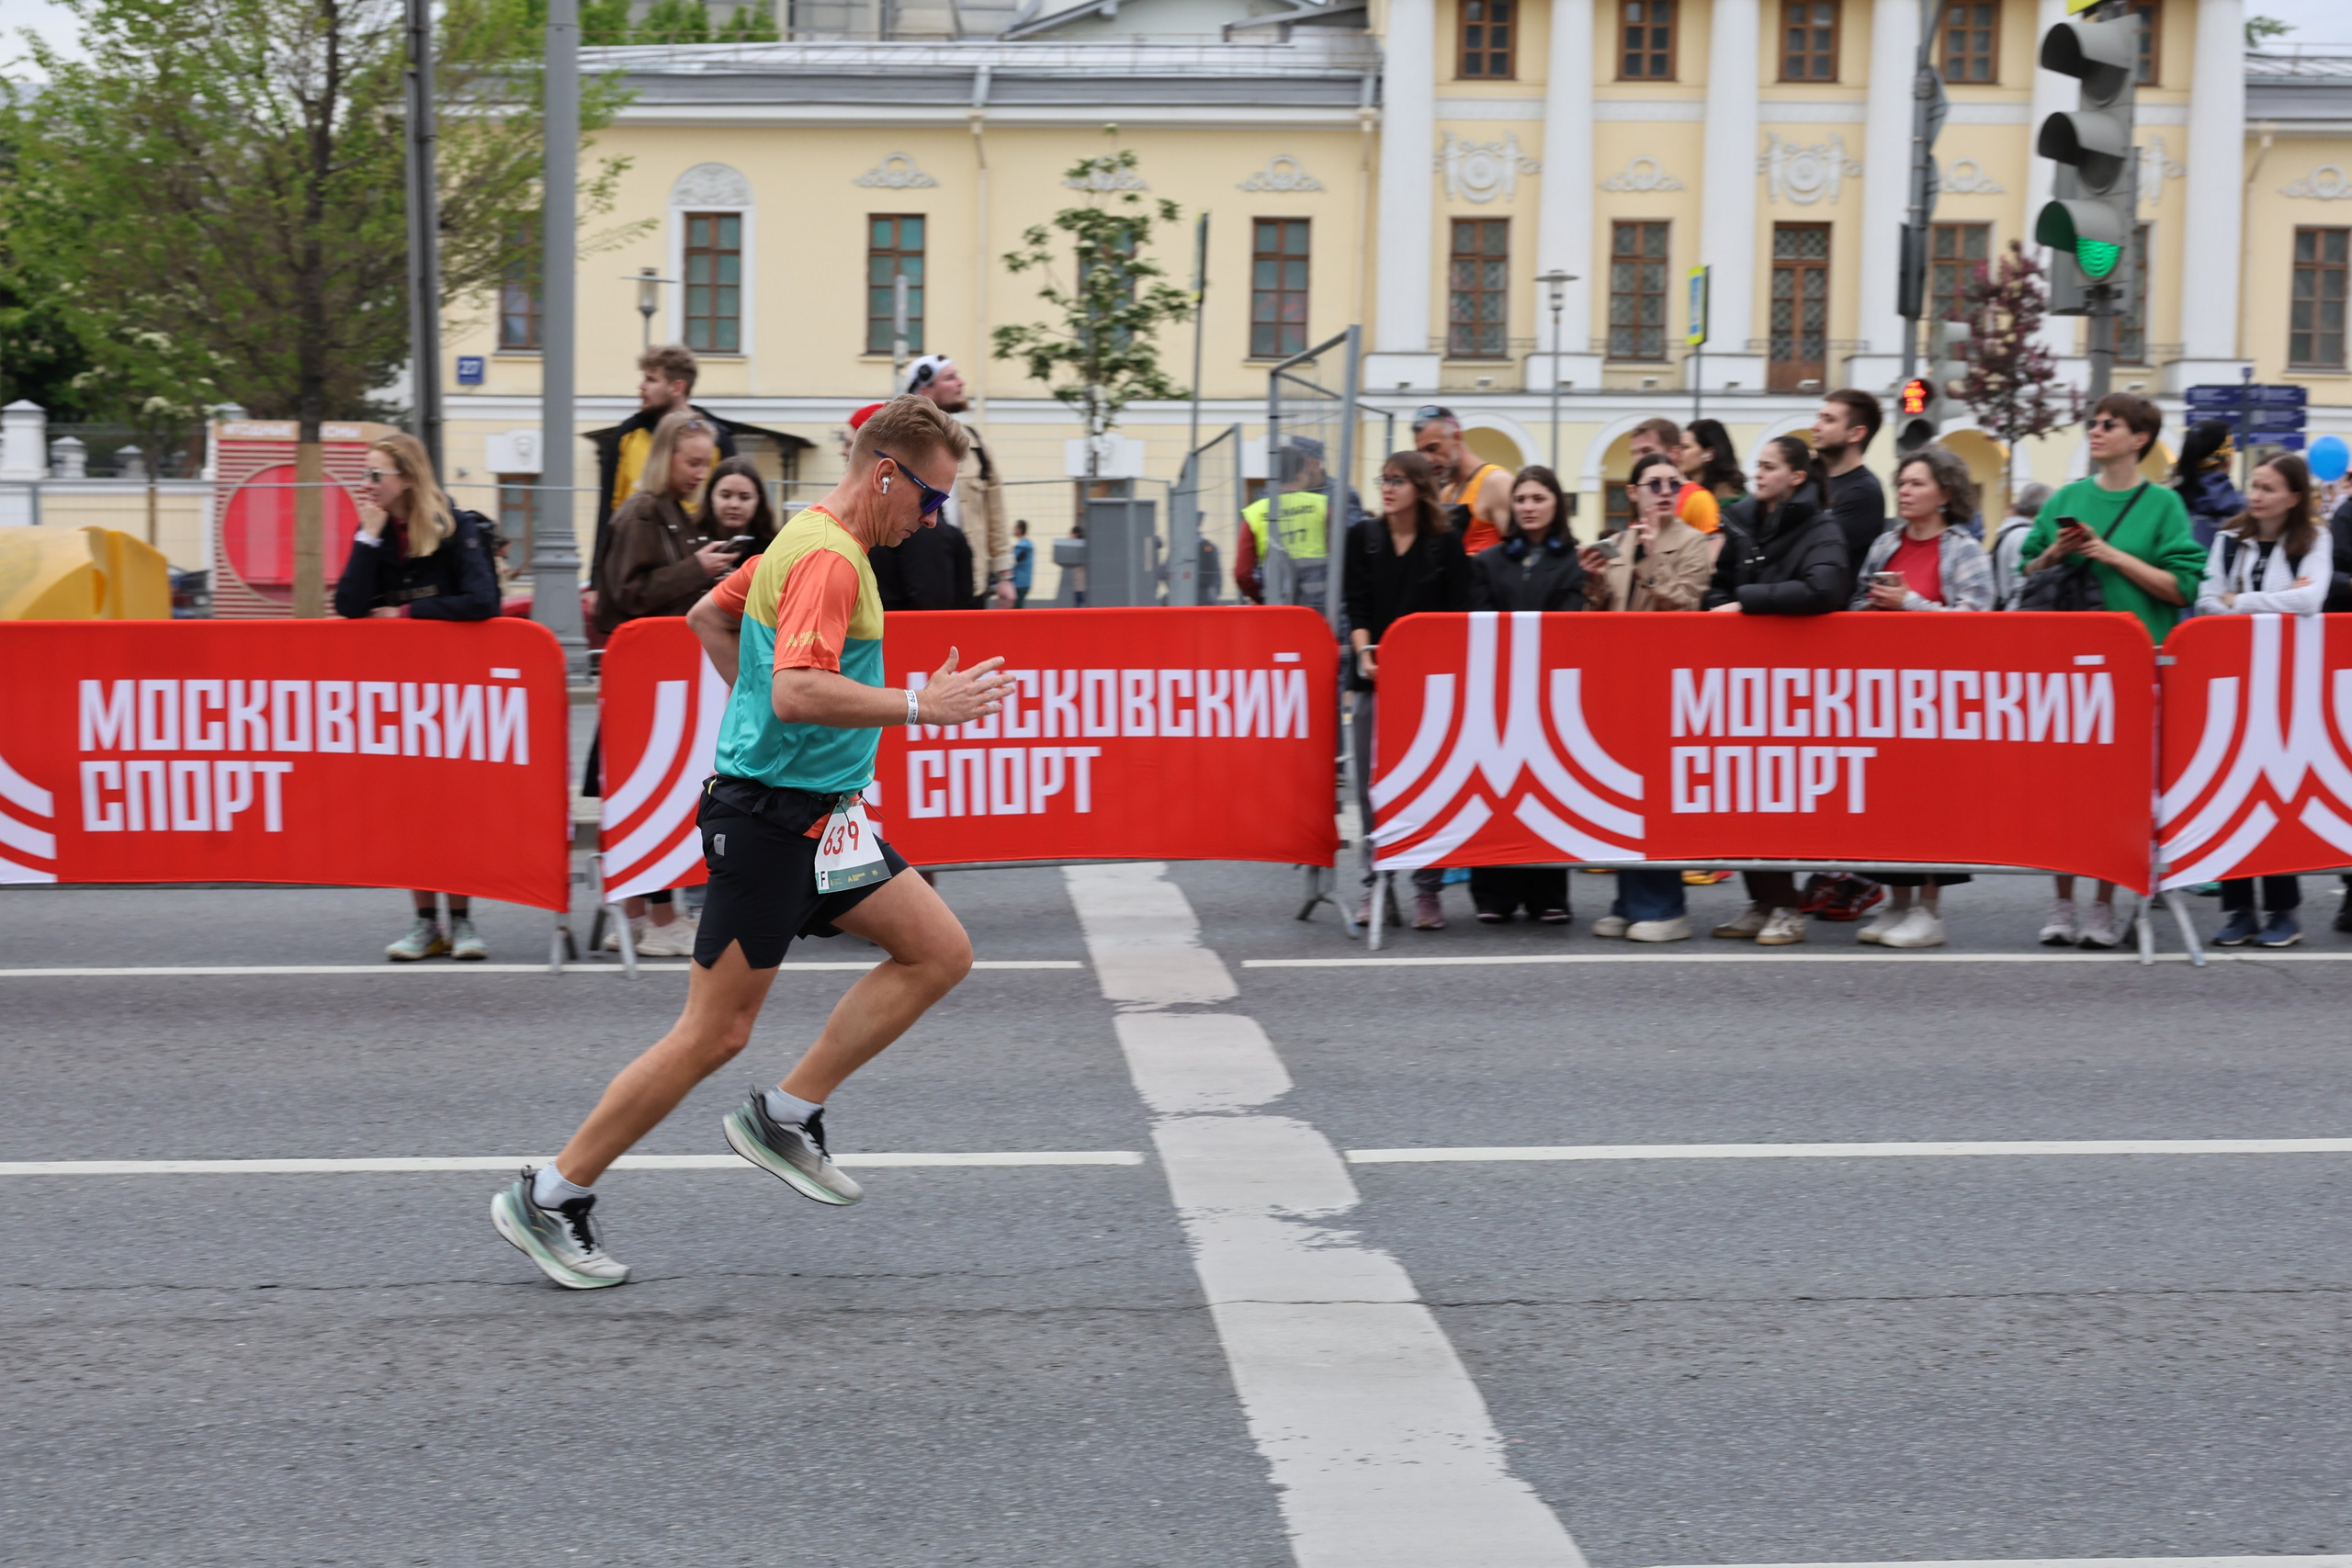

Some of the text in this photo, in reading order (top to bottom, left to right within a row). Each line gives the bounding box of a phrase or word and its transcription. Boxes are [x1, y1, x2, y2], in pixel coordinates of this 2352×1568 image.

[79, 668, 529, 765] МОСКОВСКИЙ
[1671, 655, 2114, 744] МОСКОВСКИЙ
[80, 761, 293, 832] СПОРТ
[907, 746, 1101, 818] СПОРТ
[1671, 746, 1876, 814] СПОРТ
[823, 820, 859, 855] 639
